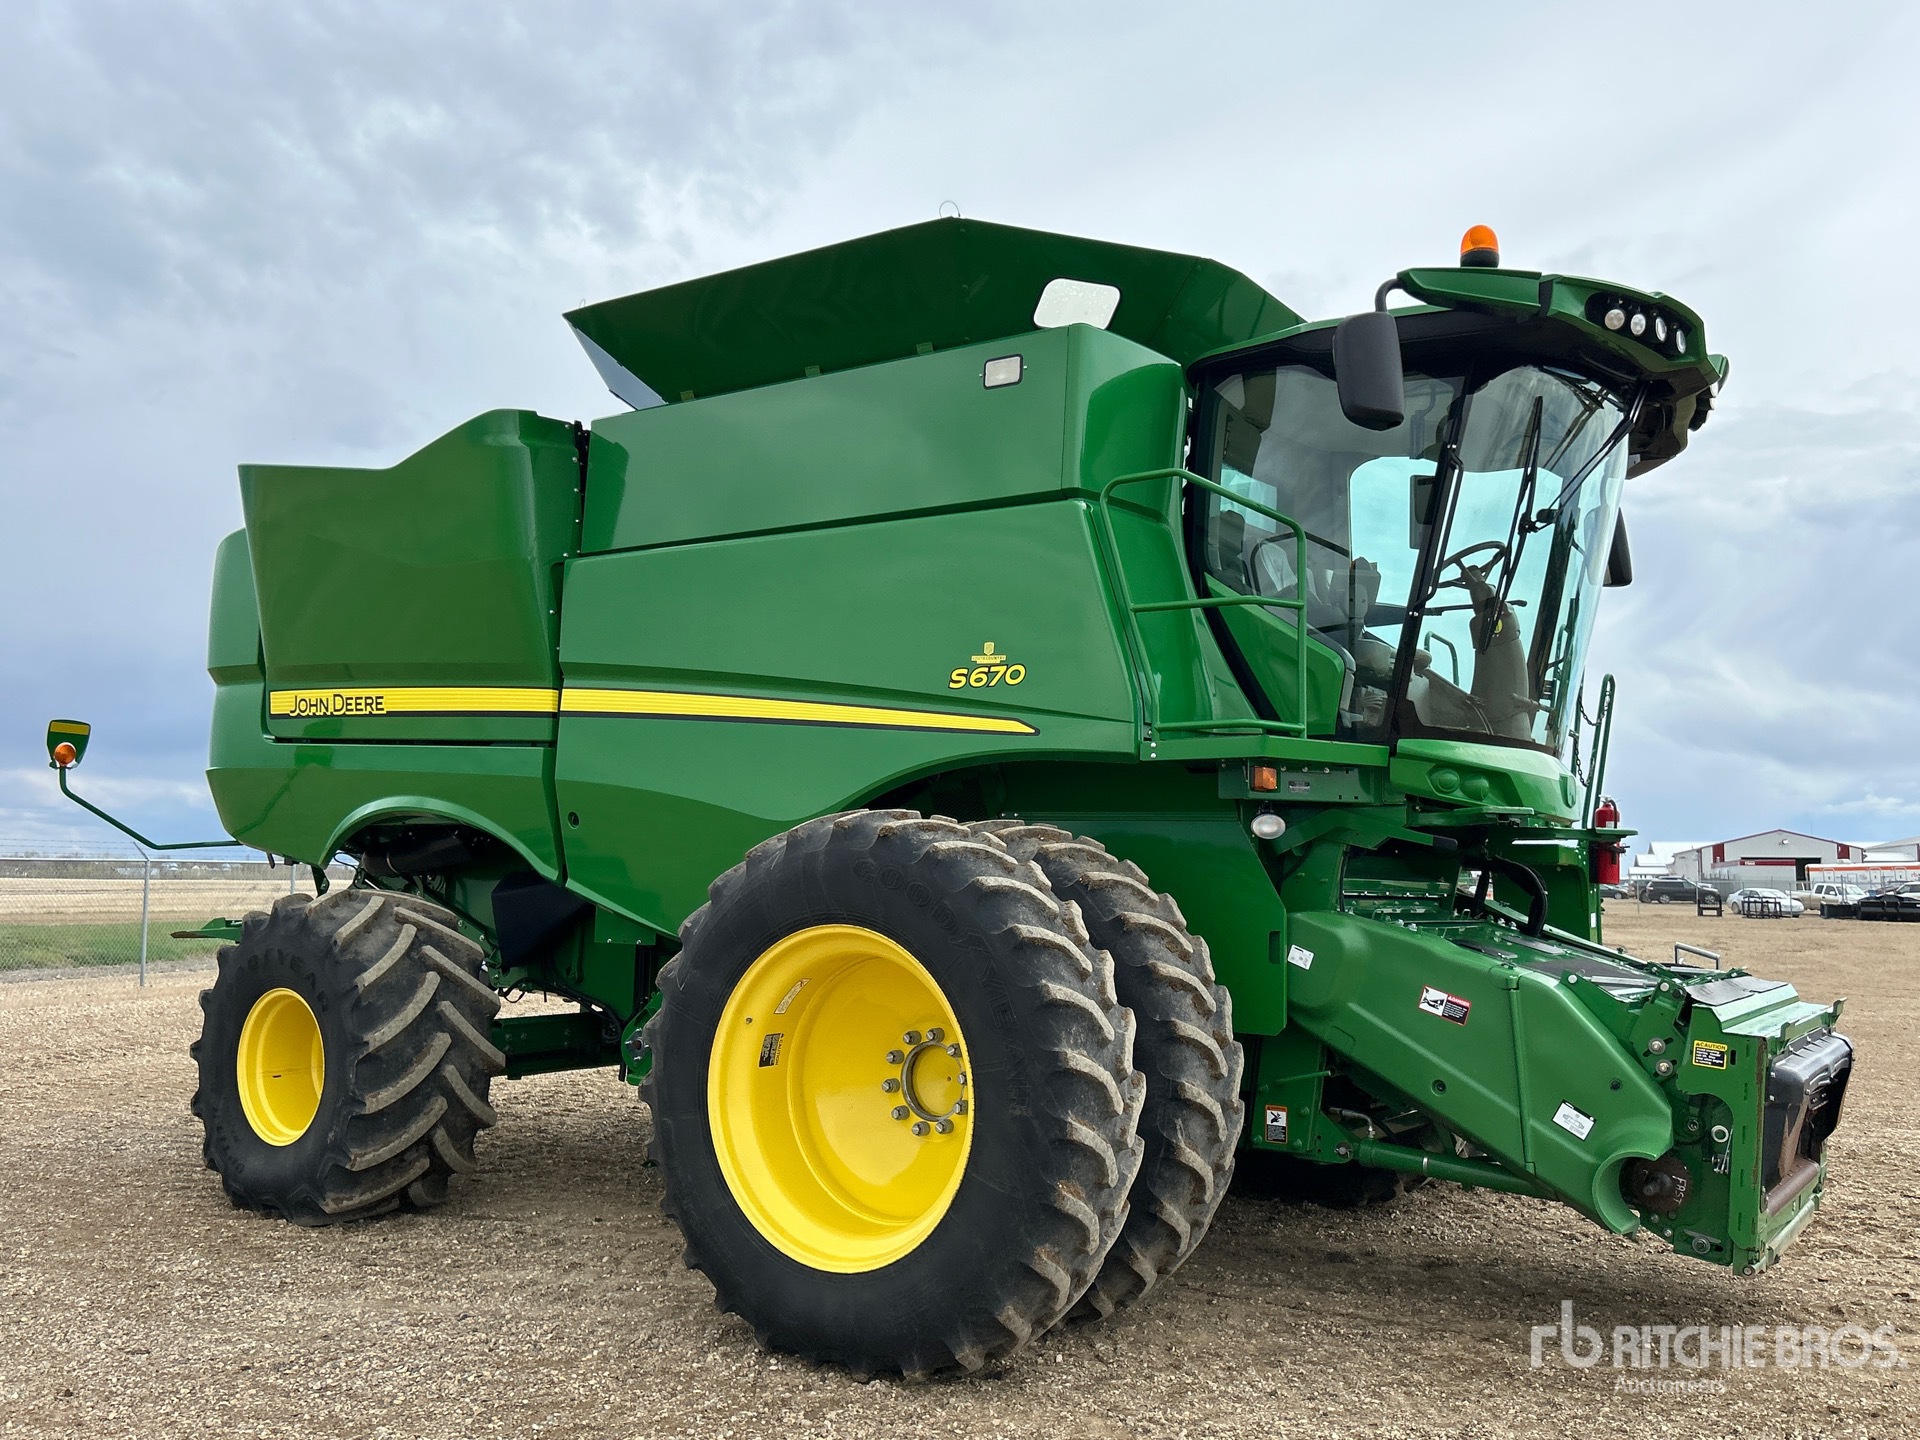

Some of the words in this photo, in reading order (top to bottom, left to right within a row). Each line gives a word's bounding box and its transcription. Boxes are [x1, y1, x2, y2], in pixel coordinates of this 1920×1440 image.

[948, 663, 1026, 689] S670
[290, 695, 329, 714] JOHN
[333, 694, 385, 713] DEERE
[1700, 1042, 1726, 1051] CAUTION
